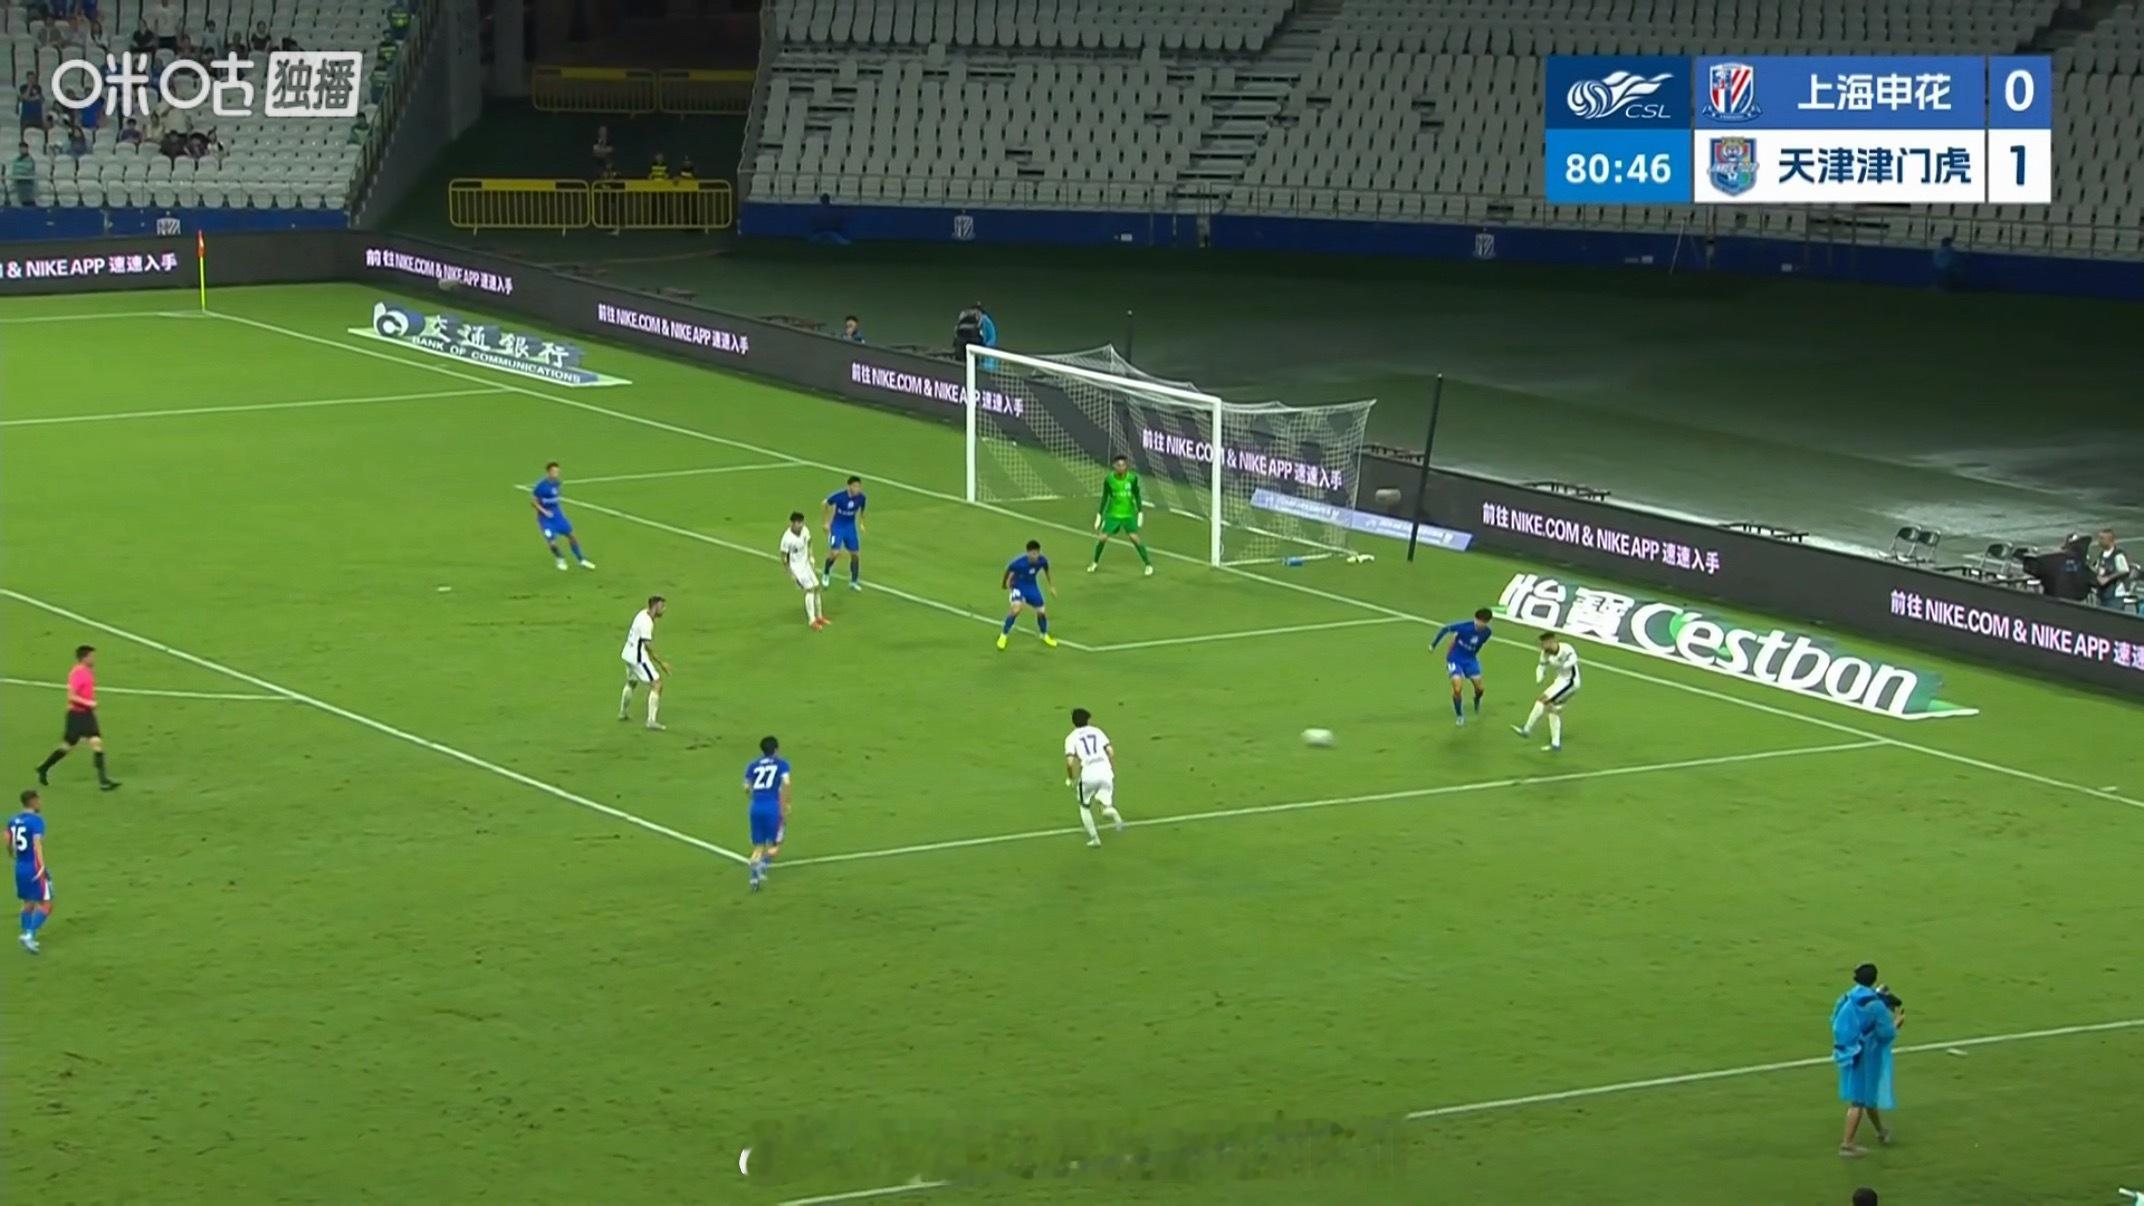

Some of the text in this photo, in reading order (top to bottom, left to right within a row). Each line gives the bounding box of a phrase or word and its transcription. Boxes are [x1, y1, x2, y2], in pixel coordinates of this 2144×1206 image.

[7, 261, 22, 278] &
[26, 258, 68, 278] NIKE
[70, 257, 105, 275] APP
[109, 253, 177, 273] 速速入手
[464, 270, 480, 287] APP
[616, 308, 661, 335] NIKE.COM
[661, 319, 669, 338] &
[670, 321, 692, 342] NIKE
[692, 327, 711, 346] APP
[412, 336, 581, 384] BANK OF COMMUNICATIONS
[872, 368, 922, 395] NIKE.COM
[923, 378, 932, 397] &
[934, 380, 958, 403] NIKE
[959, 386, 980, 407] AP
[1227, 448, 1237, 468] &
[1239, 450, 1266, 474] NIKE
[1268, 458, 1292, 480] APP
[1483, 502, 1720, 575] 前往 NIKE.COM & NIKE APP 速速入手
[1499, 573, 1634, 643] 怡寶
[1890, 589, 1922, 619] 前往
[1925, 598, 2009, 640] NIKE.COM
[2013, 619, 2027, 644] &
[2031, 622, 2072, 654] NIKE
[2074, 632, 2110, 661] APP
[1079, 734, 1097, 756] 17
[753, 765, 778, 789] 27
[10, 825, 28, 851] 15
